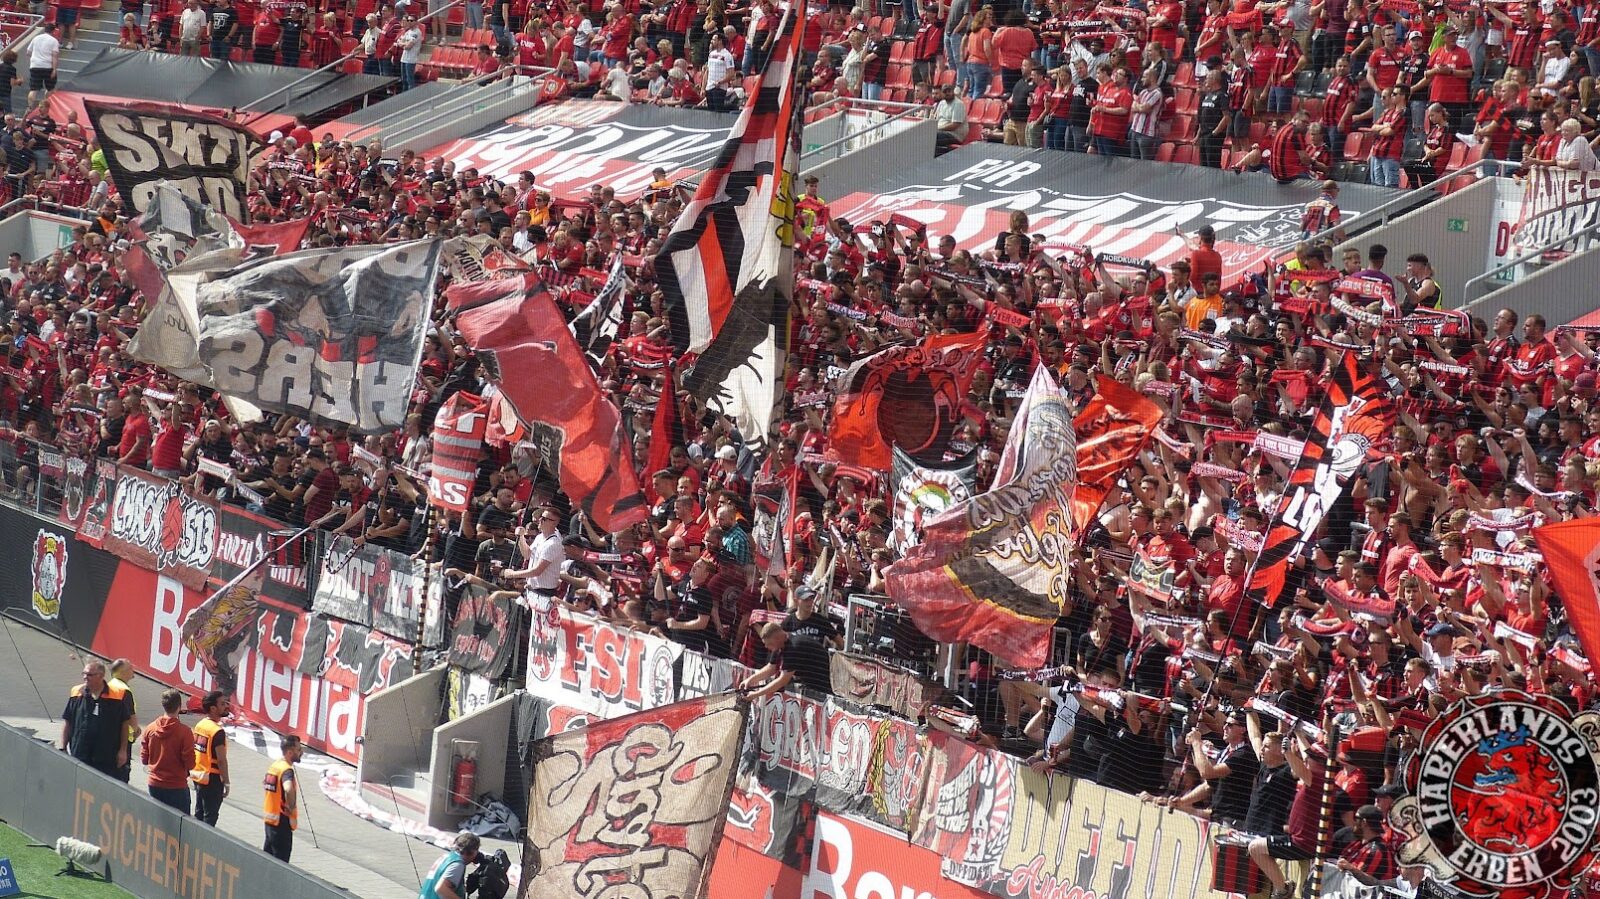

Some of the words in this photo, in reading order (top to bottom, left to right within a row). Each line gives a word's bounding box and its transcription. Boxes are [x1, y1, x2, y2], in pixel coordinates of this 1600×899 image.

[1102, 253, 1146, 267] NORDKURVE
[216, 531, 255, 569] FORZA
[559, 613, 648, 713] FSI
[73, 787, 96, 843] IT
[1000, 764, 1216, 899] DIFFID
